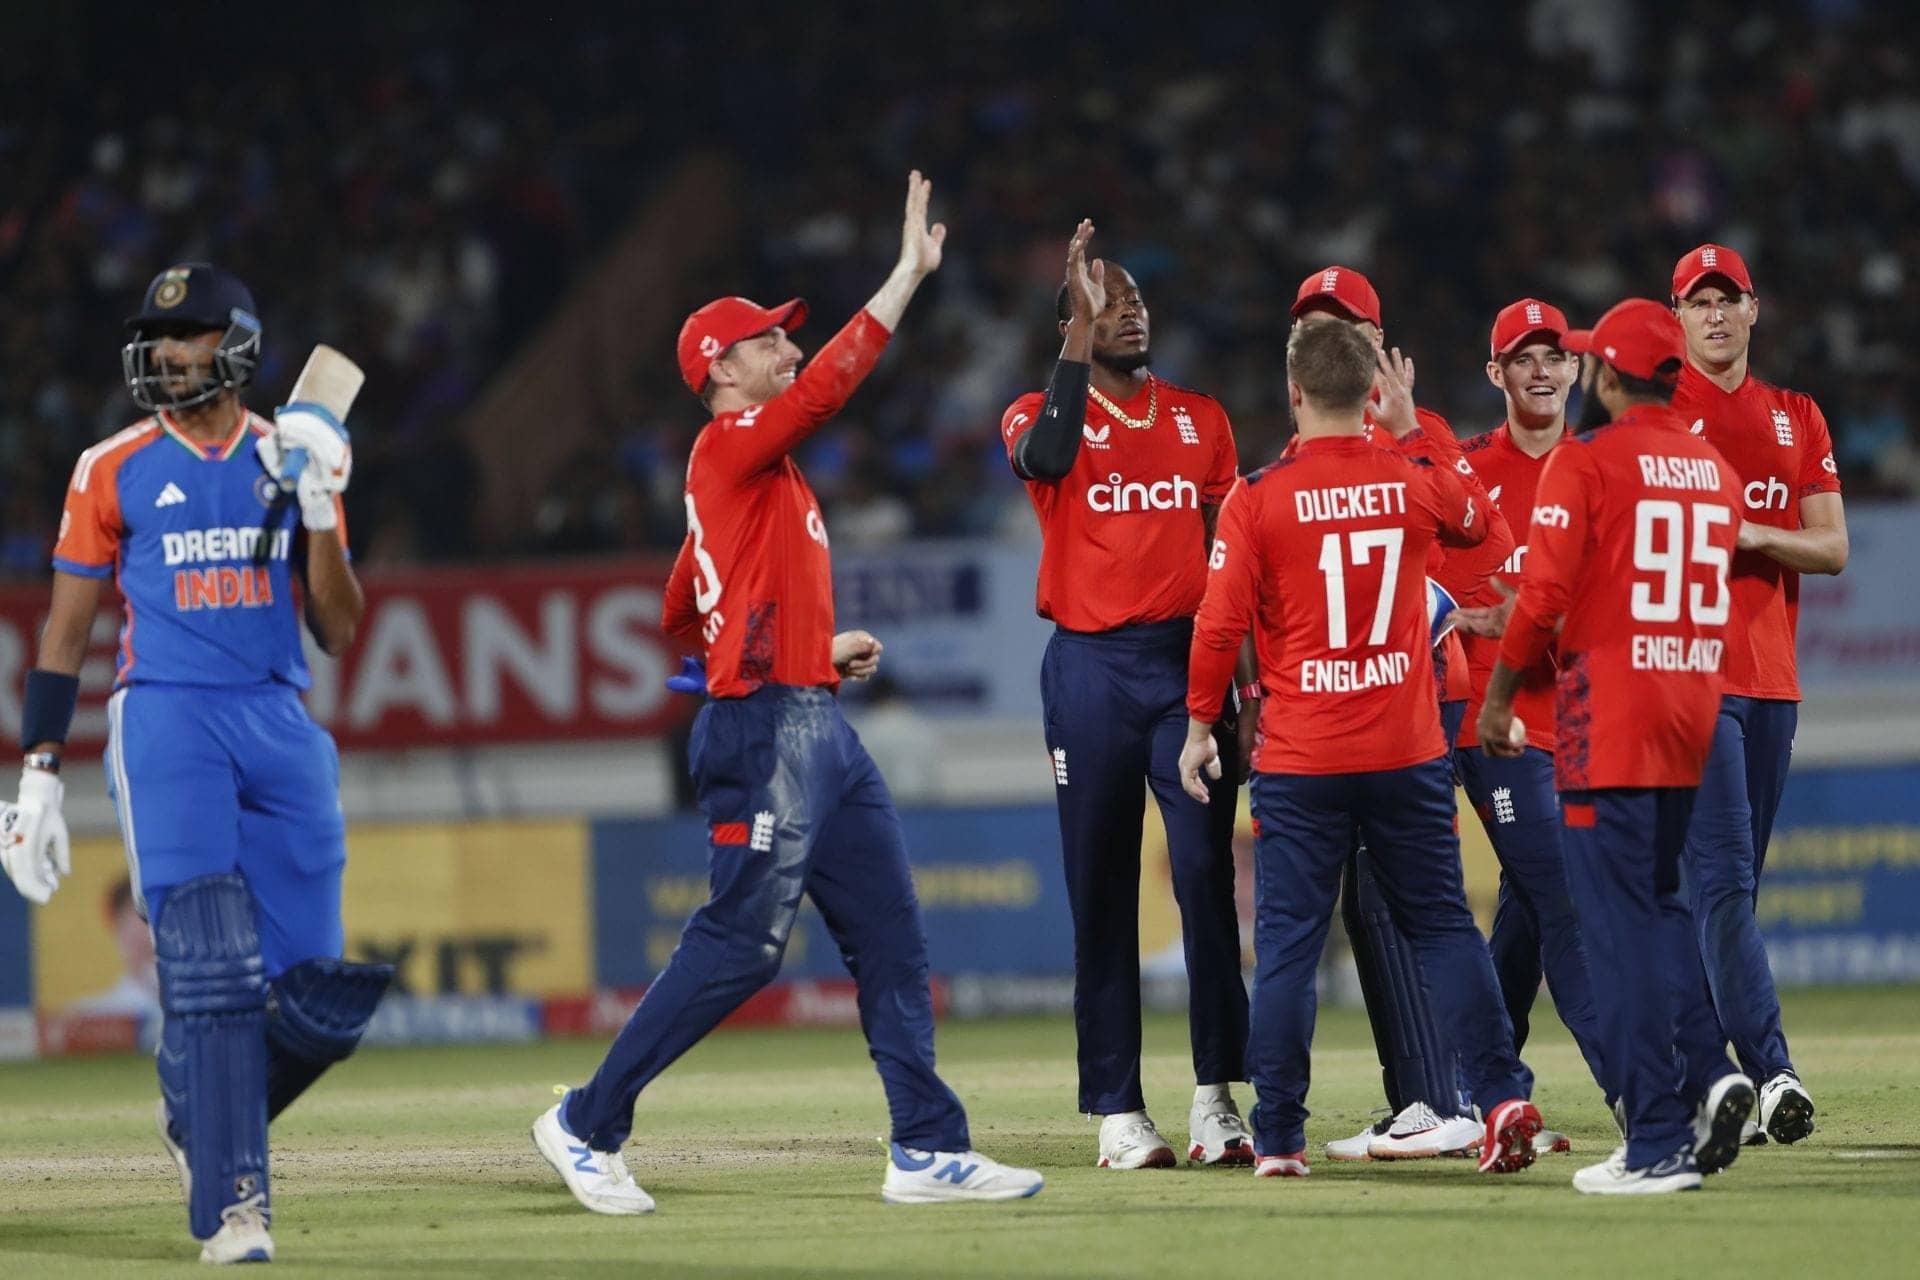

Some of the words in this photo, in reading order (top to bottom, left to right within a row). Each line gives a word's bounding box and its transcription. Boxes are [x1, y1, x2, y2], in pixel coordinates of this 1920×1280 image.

[1087, 472, 1198, 512] cinch
[1638, 454, 1720, 491] RASHID
[1294, 482, 1406, 522] DUCKETT
[1631, 499, 1731, 626] 95
[174, 566, 274, 612] INDIA
[1318, 527, 1404, 649] 17
[1300, 652, 1410, 693] ENGLAND
[1631, 635, 1724, 673] ENGLAND
